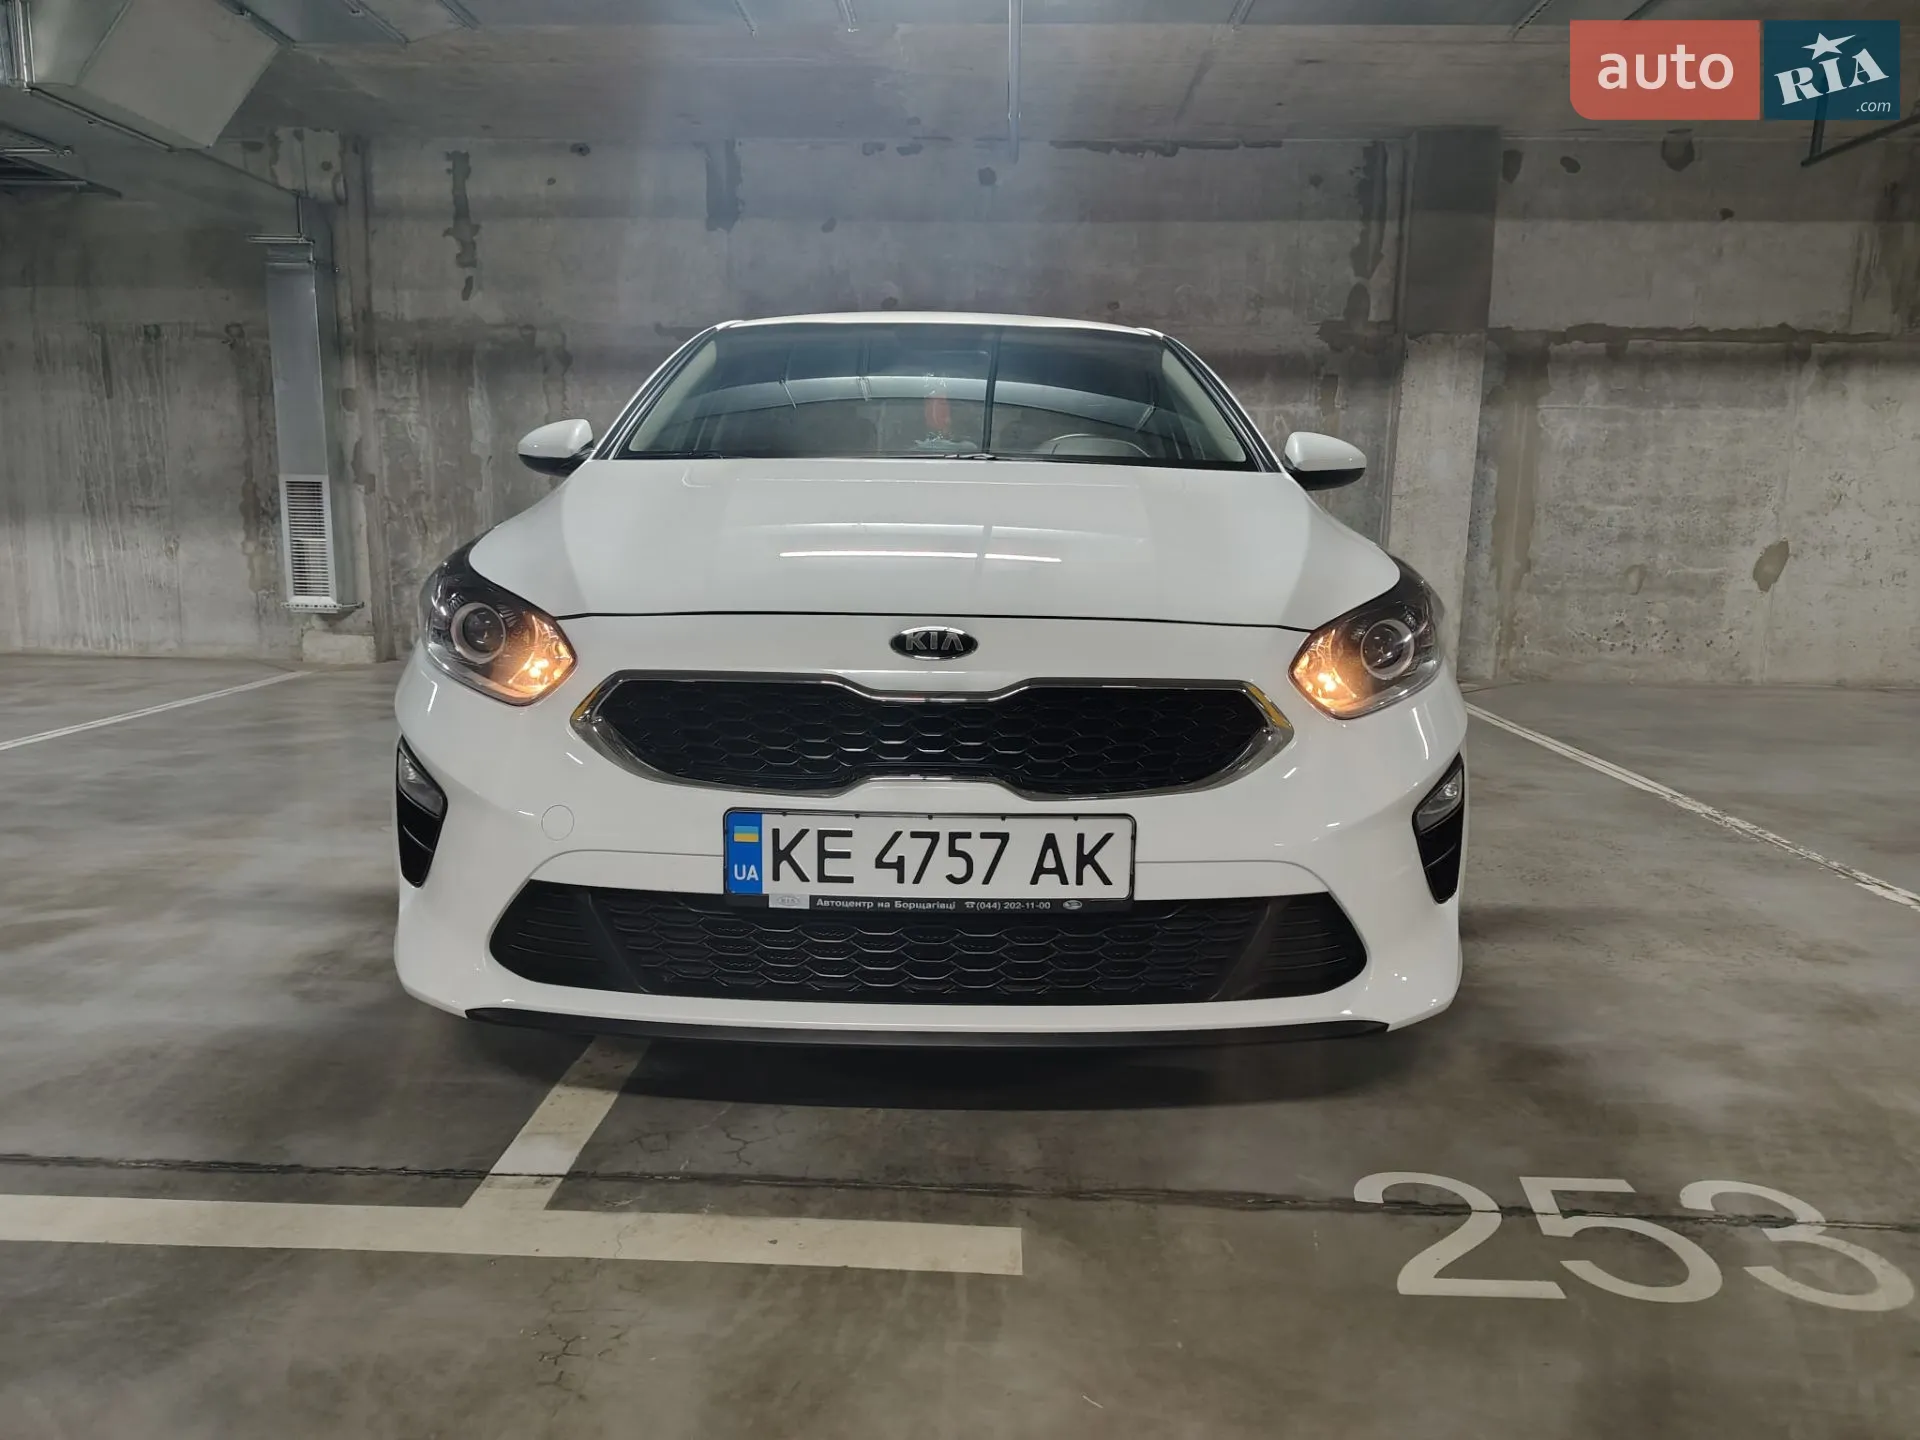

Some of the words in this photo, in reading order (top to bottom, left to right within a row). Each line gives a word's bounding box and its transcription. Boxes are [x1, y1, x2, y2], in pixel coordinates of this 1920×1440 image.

[905, 631, 964, 651] KIA
[772, 828, 855, 883] KE
[874, 830, 1010, 886] 4757
[1029, 832, 1115, 886] AK
[734, 864, 759, 882] UA
[816, 898, 874, 909] Автоцентр
[894, 900, 956, 910] Борщагівці
[976, 901, 1001, 911] (044)
[1003, 901, 1051, 910] 202-11-00
[1353, 1171, 1915, 1312] 253
